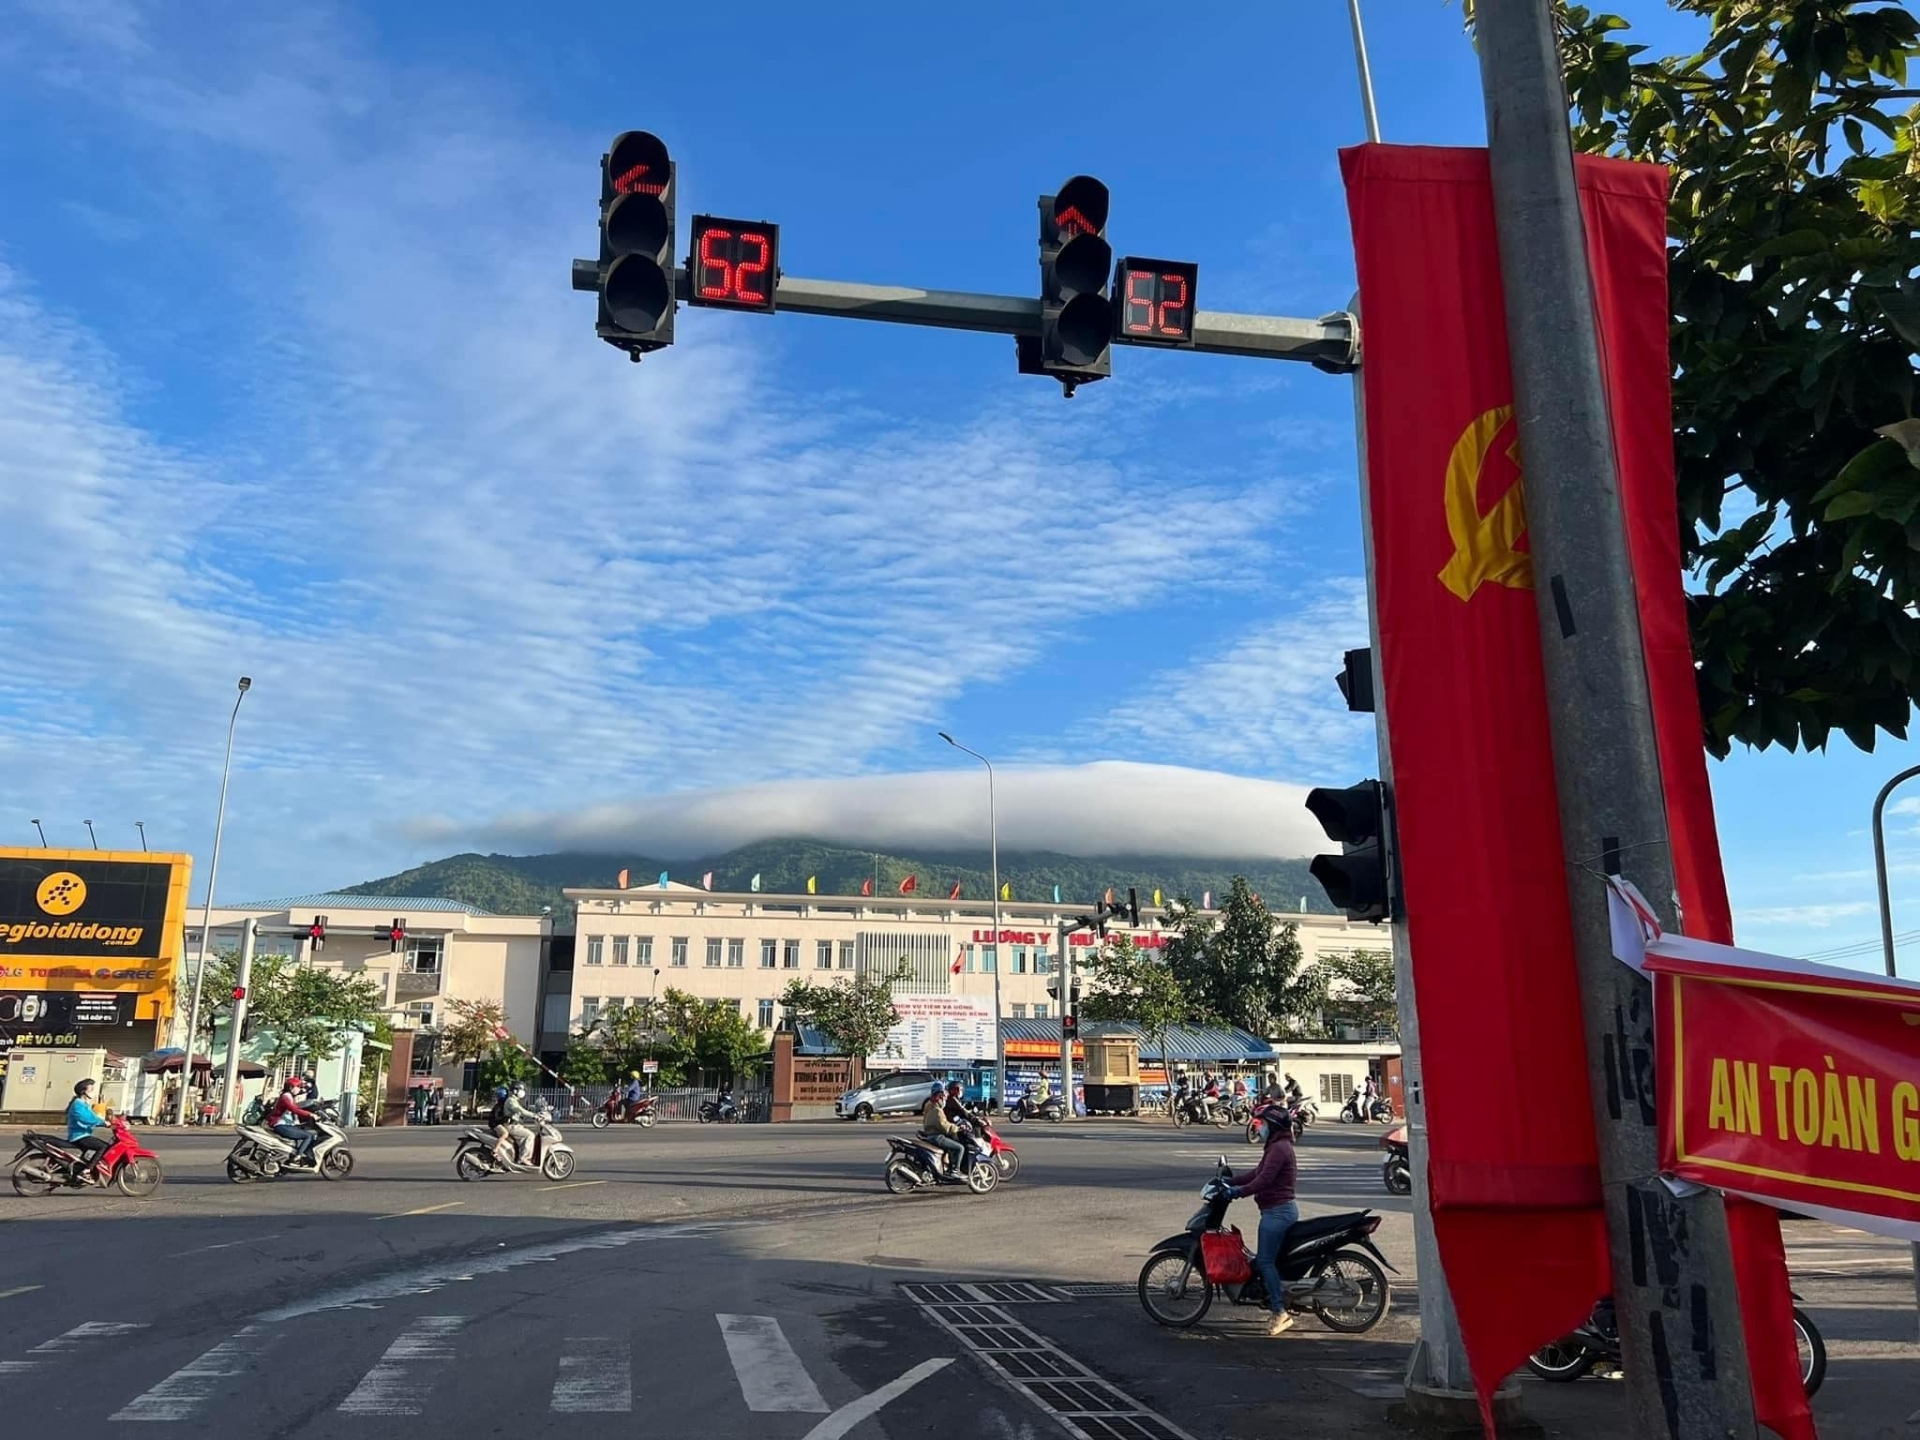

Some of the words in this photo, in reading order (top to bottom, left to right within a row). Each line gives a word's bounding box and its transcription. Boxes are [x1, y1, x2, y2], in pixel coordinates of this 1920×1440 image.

[701, 229, 769, 300] 52
[1127, 270, 1187, 334] 52
[1037, 932, 1051, 945] Y
[35, 1033, 53, 1045] VÔ
[54, 1032, 77, 1045] ĐỐI
[1709, 1058, 1762, 1136] AN
[1769, 1055, 1880, 1154] TOÀN
[1892, 1081, 1920, 1161] G
